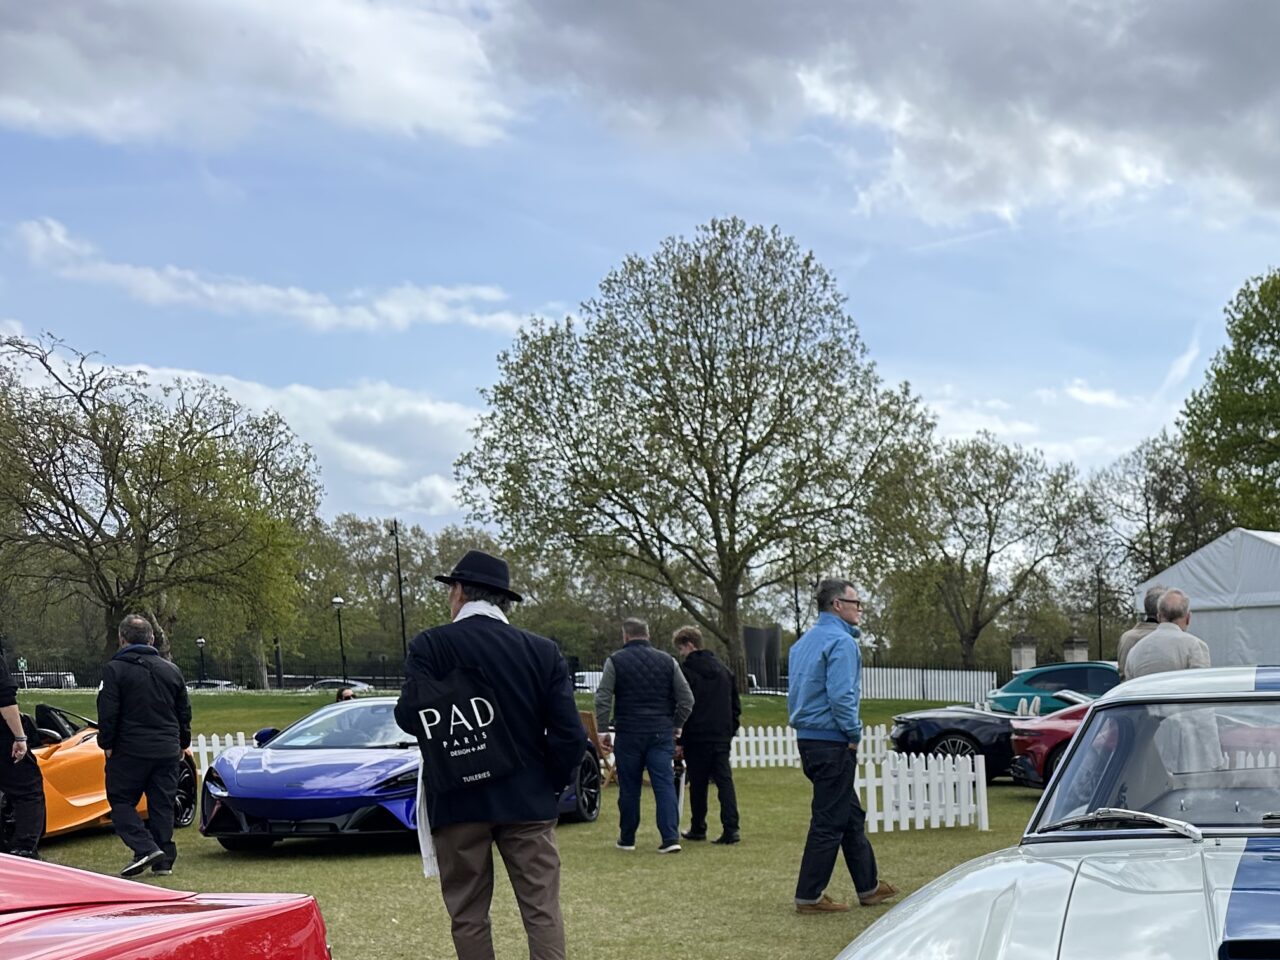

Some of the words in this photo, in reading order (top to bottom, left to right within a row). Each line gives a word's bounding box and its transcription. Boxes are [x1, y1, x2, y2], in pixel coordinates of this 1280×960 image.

[418, 696, 495, 740] PAD
[442, 731, 488, 749] PARIS
[462, 771, 491, 783] TUILERIES
